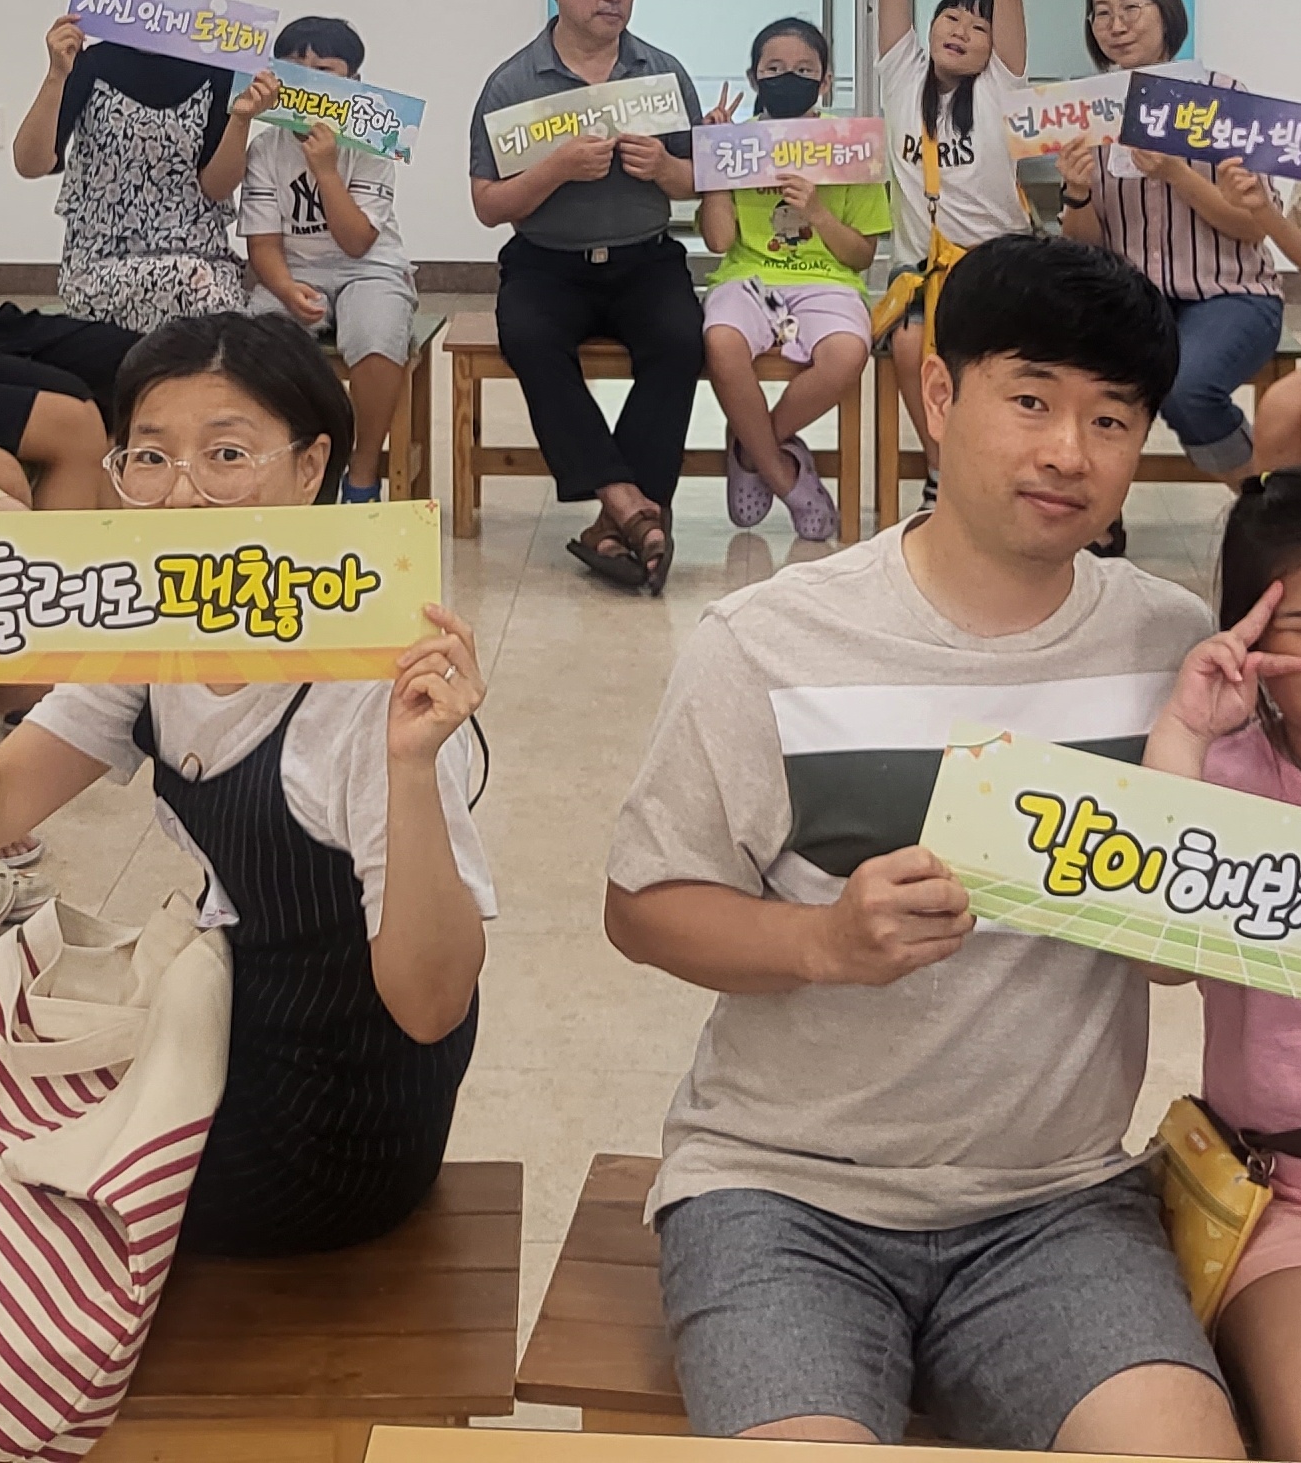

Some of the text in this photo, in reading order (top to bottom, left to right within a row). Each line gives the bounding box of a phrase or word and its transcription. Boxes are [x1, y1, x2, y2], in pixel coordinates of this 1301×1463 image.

[190, 11, 268, 56] 도전해
[351, 94, 400, 138] 좋아
[498, 91, 680, 157] 네 미래가 기대돼
[1007, 101, 1039, 138] 넌
[1139, 101, 1171, 138] 넌
[1174, 99, 1266, 155] 별보다
[714, 138, 872, 179] 친구 배려하기
[154, 544, 381, 642] 괜찮아
[1015, 789, 1167, 896] 같이
